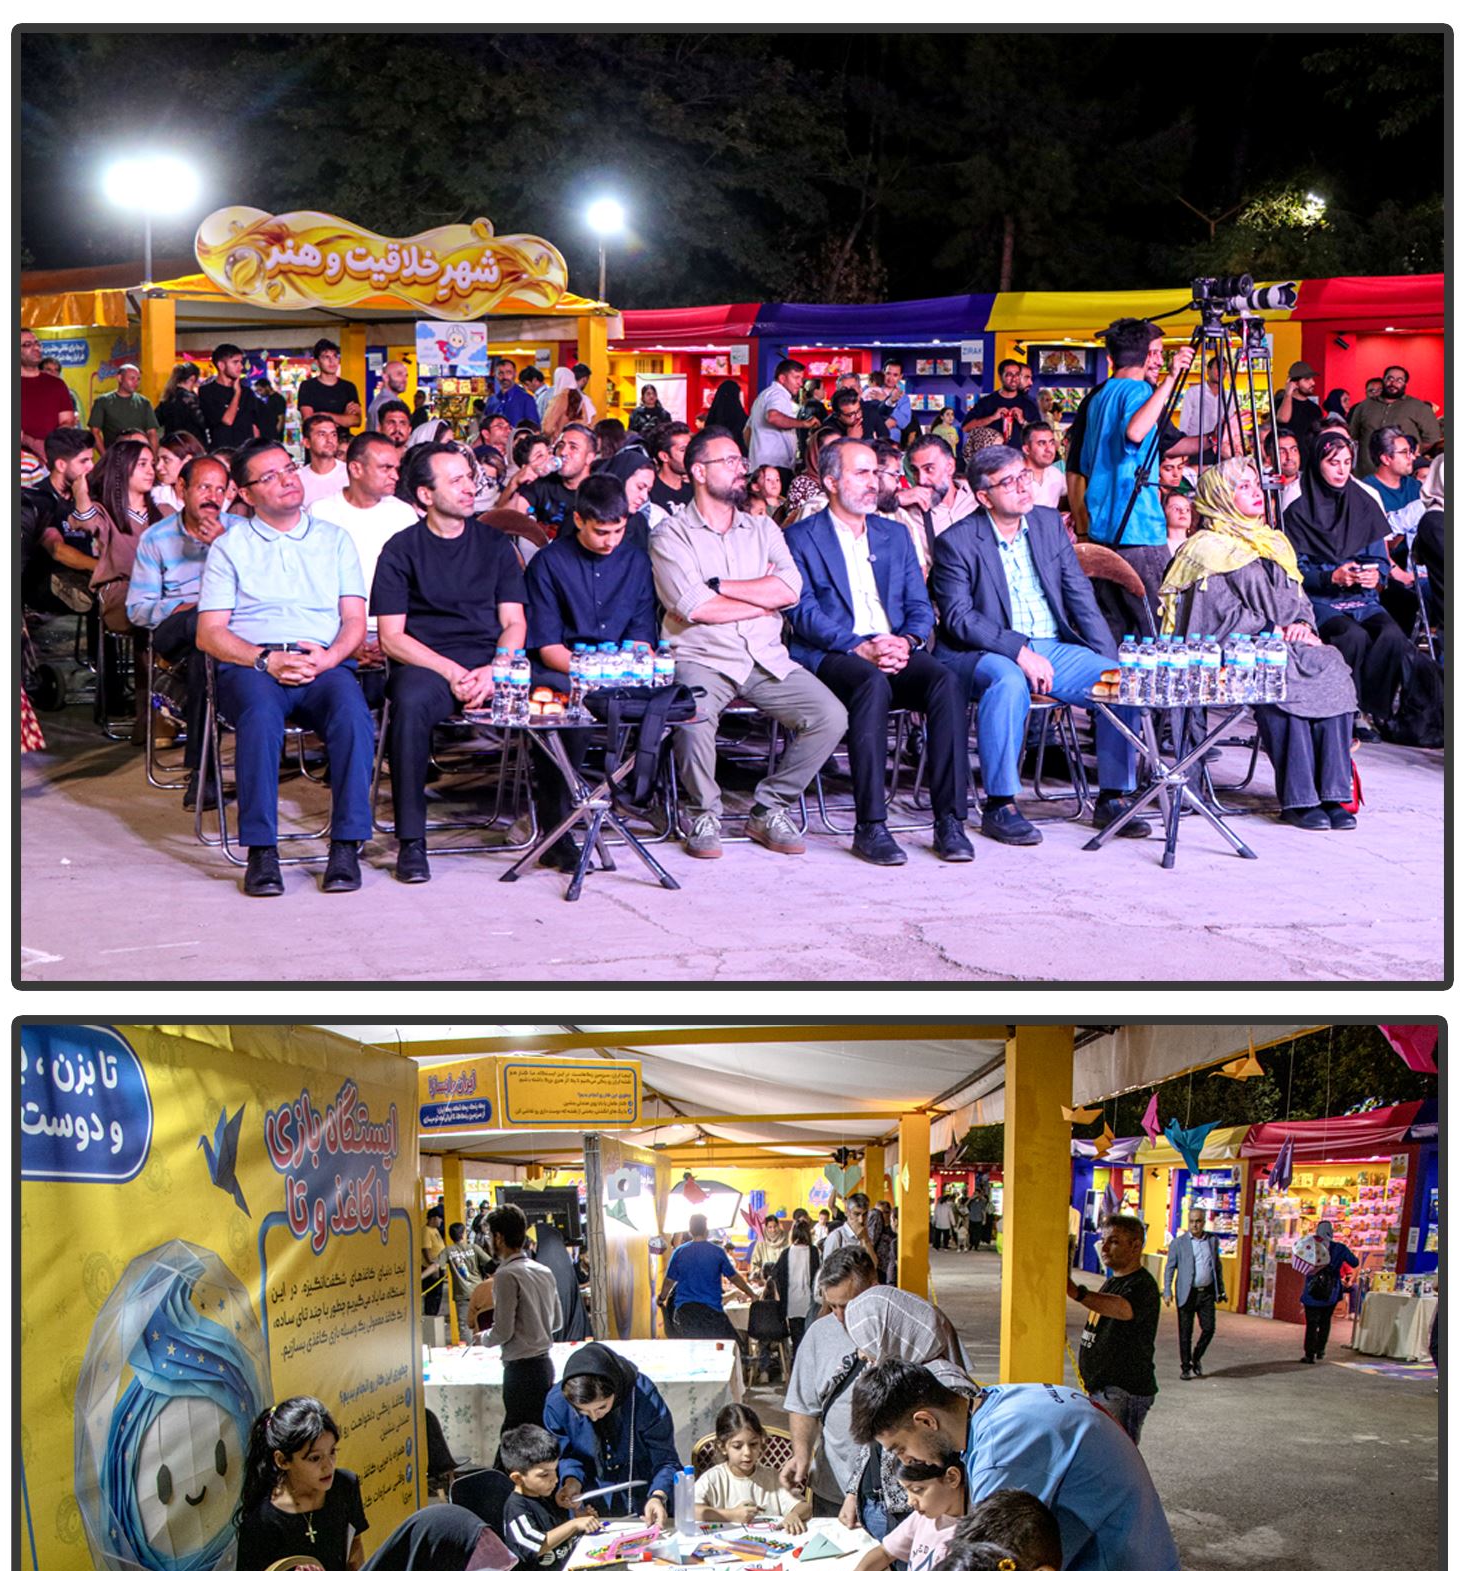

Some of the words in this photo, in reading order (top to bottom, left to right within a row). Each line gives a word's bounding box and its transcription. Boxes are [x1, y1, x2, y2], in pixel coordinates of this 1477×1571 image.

[266, 239, 323, 271] هنر
[325, 252, 341, 277] و
[344, 243, 440, 283] خلاقیت
[52, 1052, 97, 1096] بزن
[98, 1050, 118, 1089] تا
[110, 1121, 124, 1154] و
[266, 1091, 324, 1170] بازی
[324, 1083, 398, 1169] ایستگاه
[286, 1175, 310, 1236] تا
[331, 1166, 375, 1233] کاغذ
[375, 1178, 390, 1243] با
[312, 1198, 328, 1252] و
[270, 1280, 287, 1304] این
